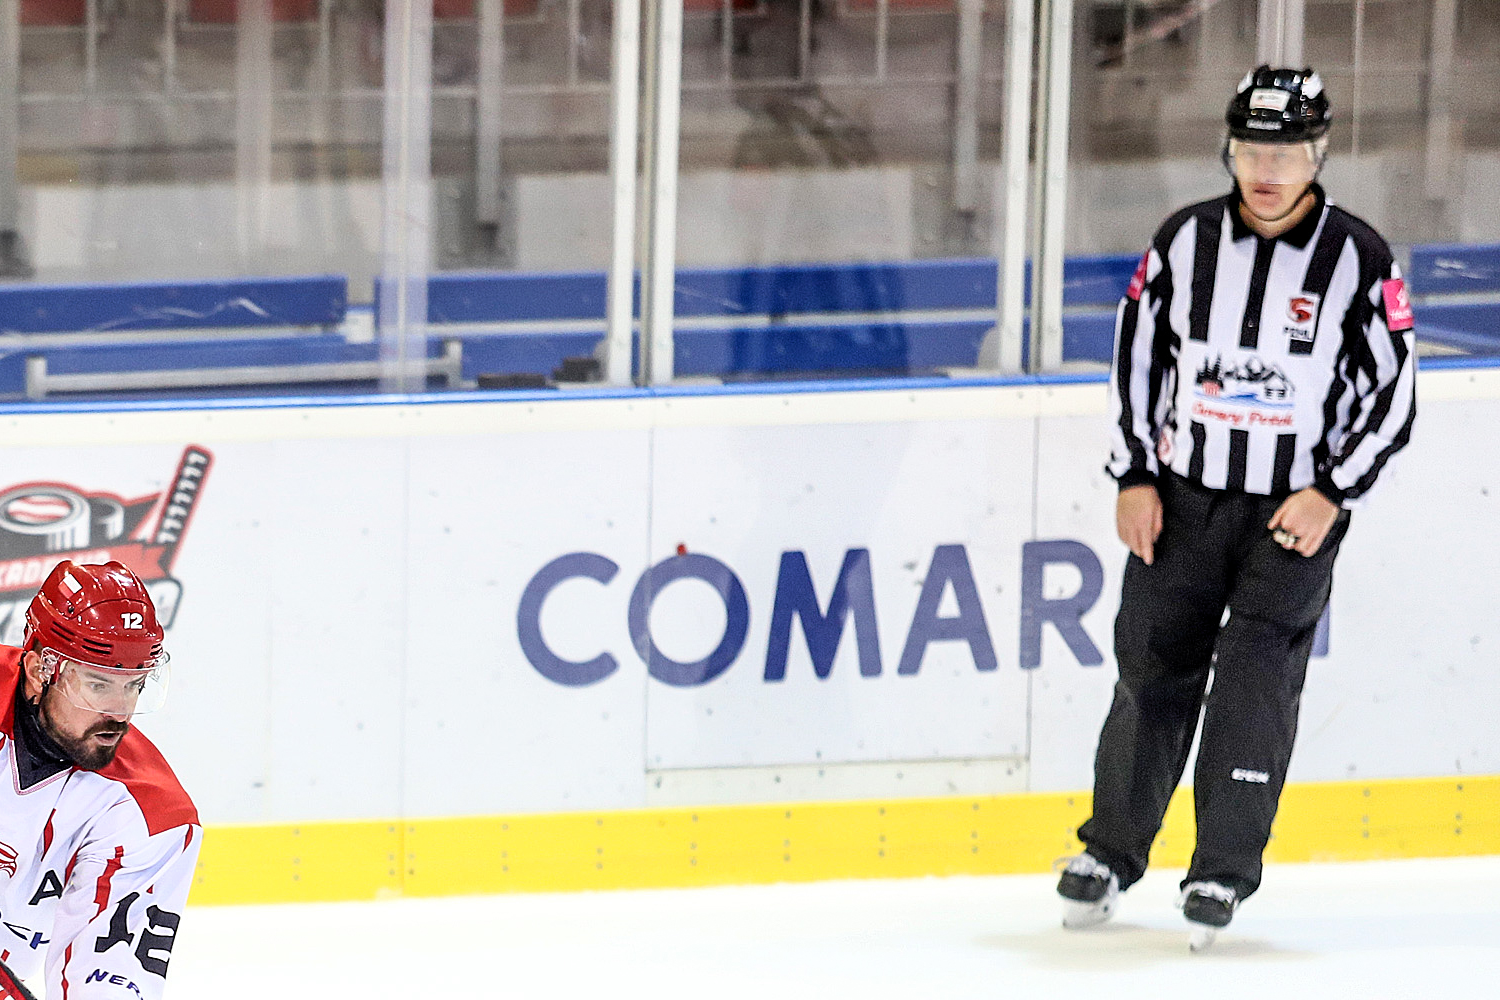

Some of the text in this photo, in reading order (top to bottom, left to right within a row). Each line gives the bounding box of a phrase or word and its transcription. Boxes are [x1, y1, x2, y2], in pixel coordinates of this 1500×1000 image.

[121, 613, 143, 629] 12
[517, 540, 1329, 688] COMAR
[28, 870, 63, 906] A
